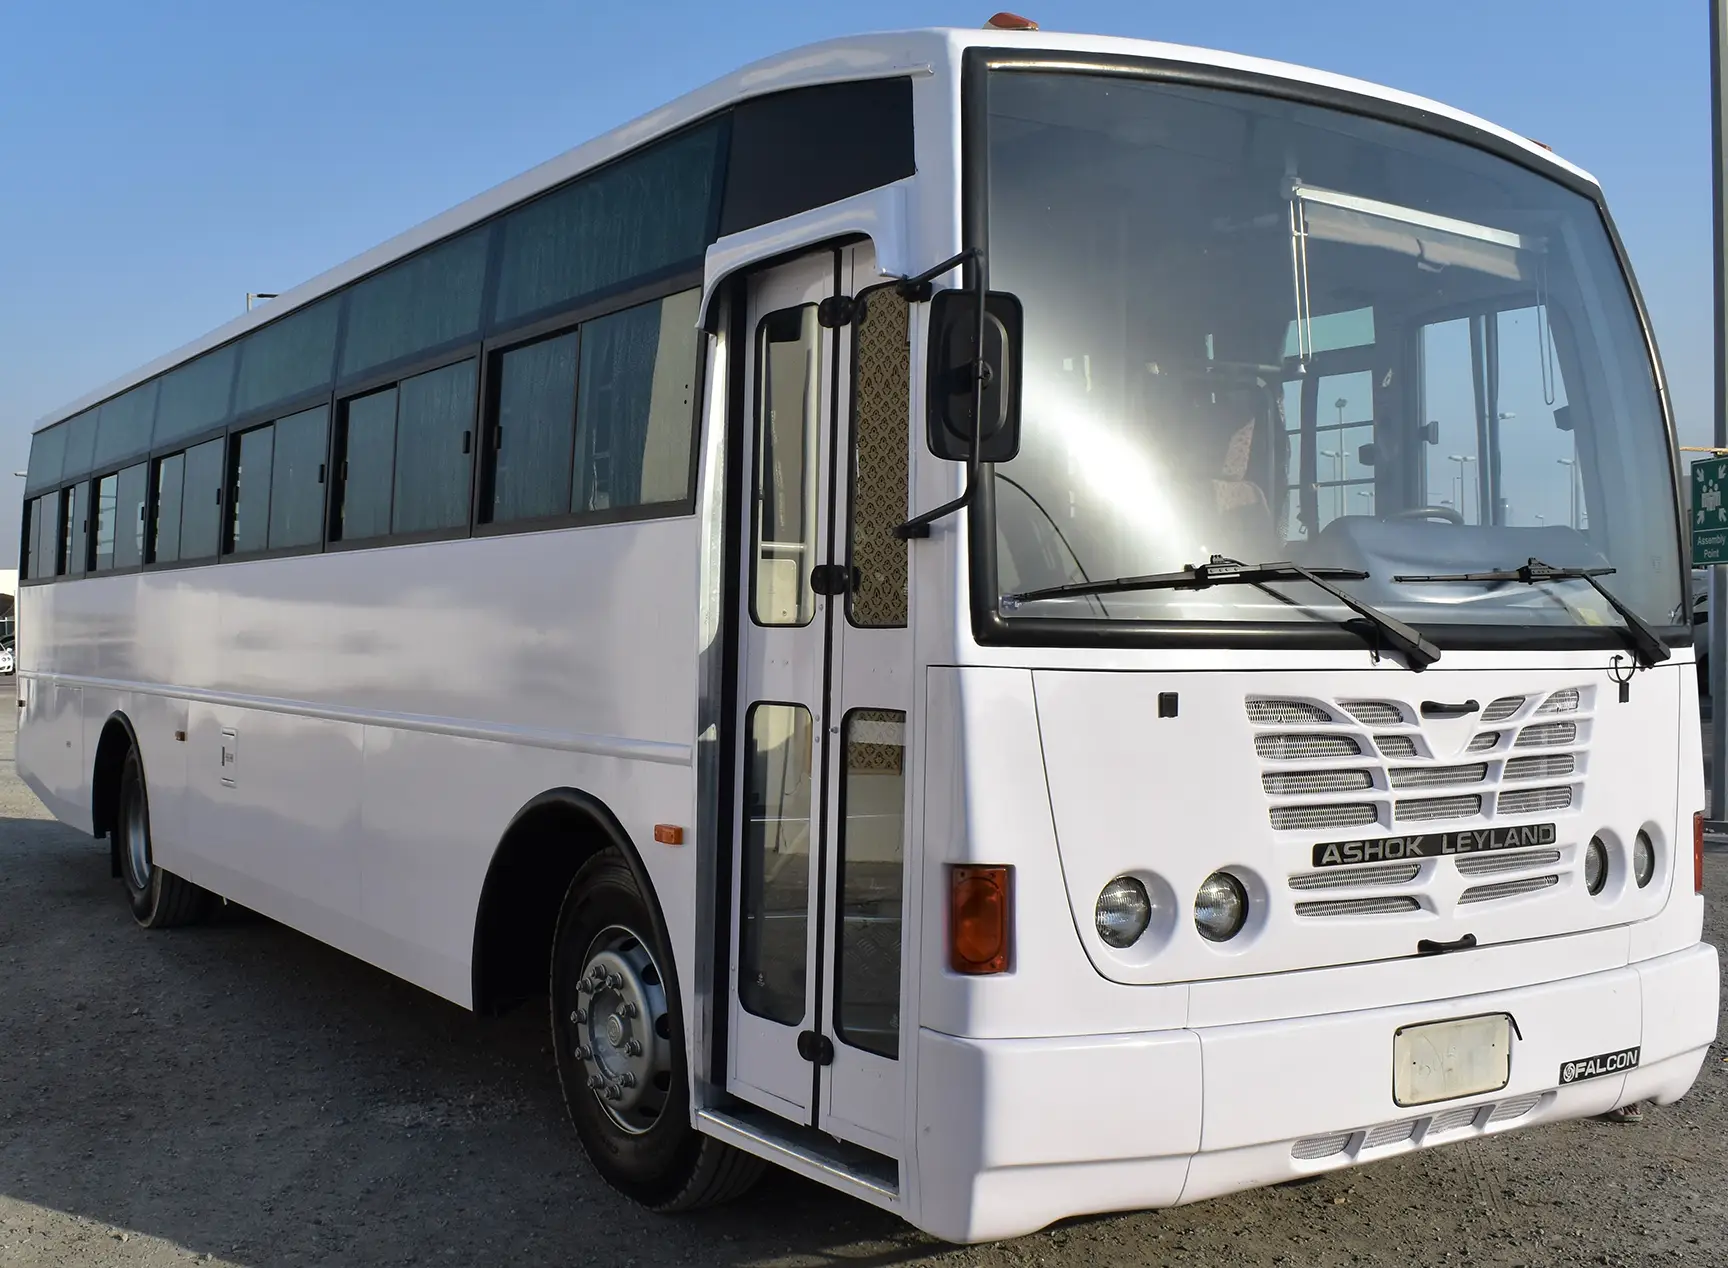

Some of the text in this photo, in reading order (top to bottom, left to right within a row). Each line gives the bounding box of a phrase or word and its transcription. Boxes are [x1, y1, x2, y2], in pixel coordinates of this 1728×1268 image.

[1697, 534, 1726, 546] Assembly
[1703, 549, 1719, 558] Point
[1320, 824, 1555, 865] ASHOK LEYLAND
[1574, 1049, 1638, 1078] FALCON
